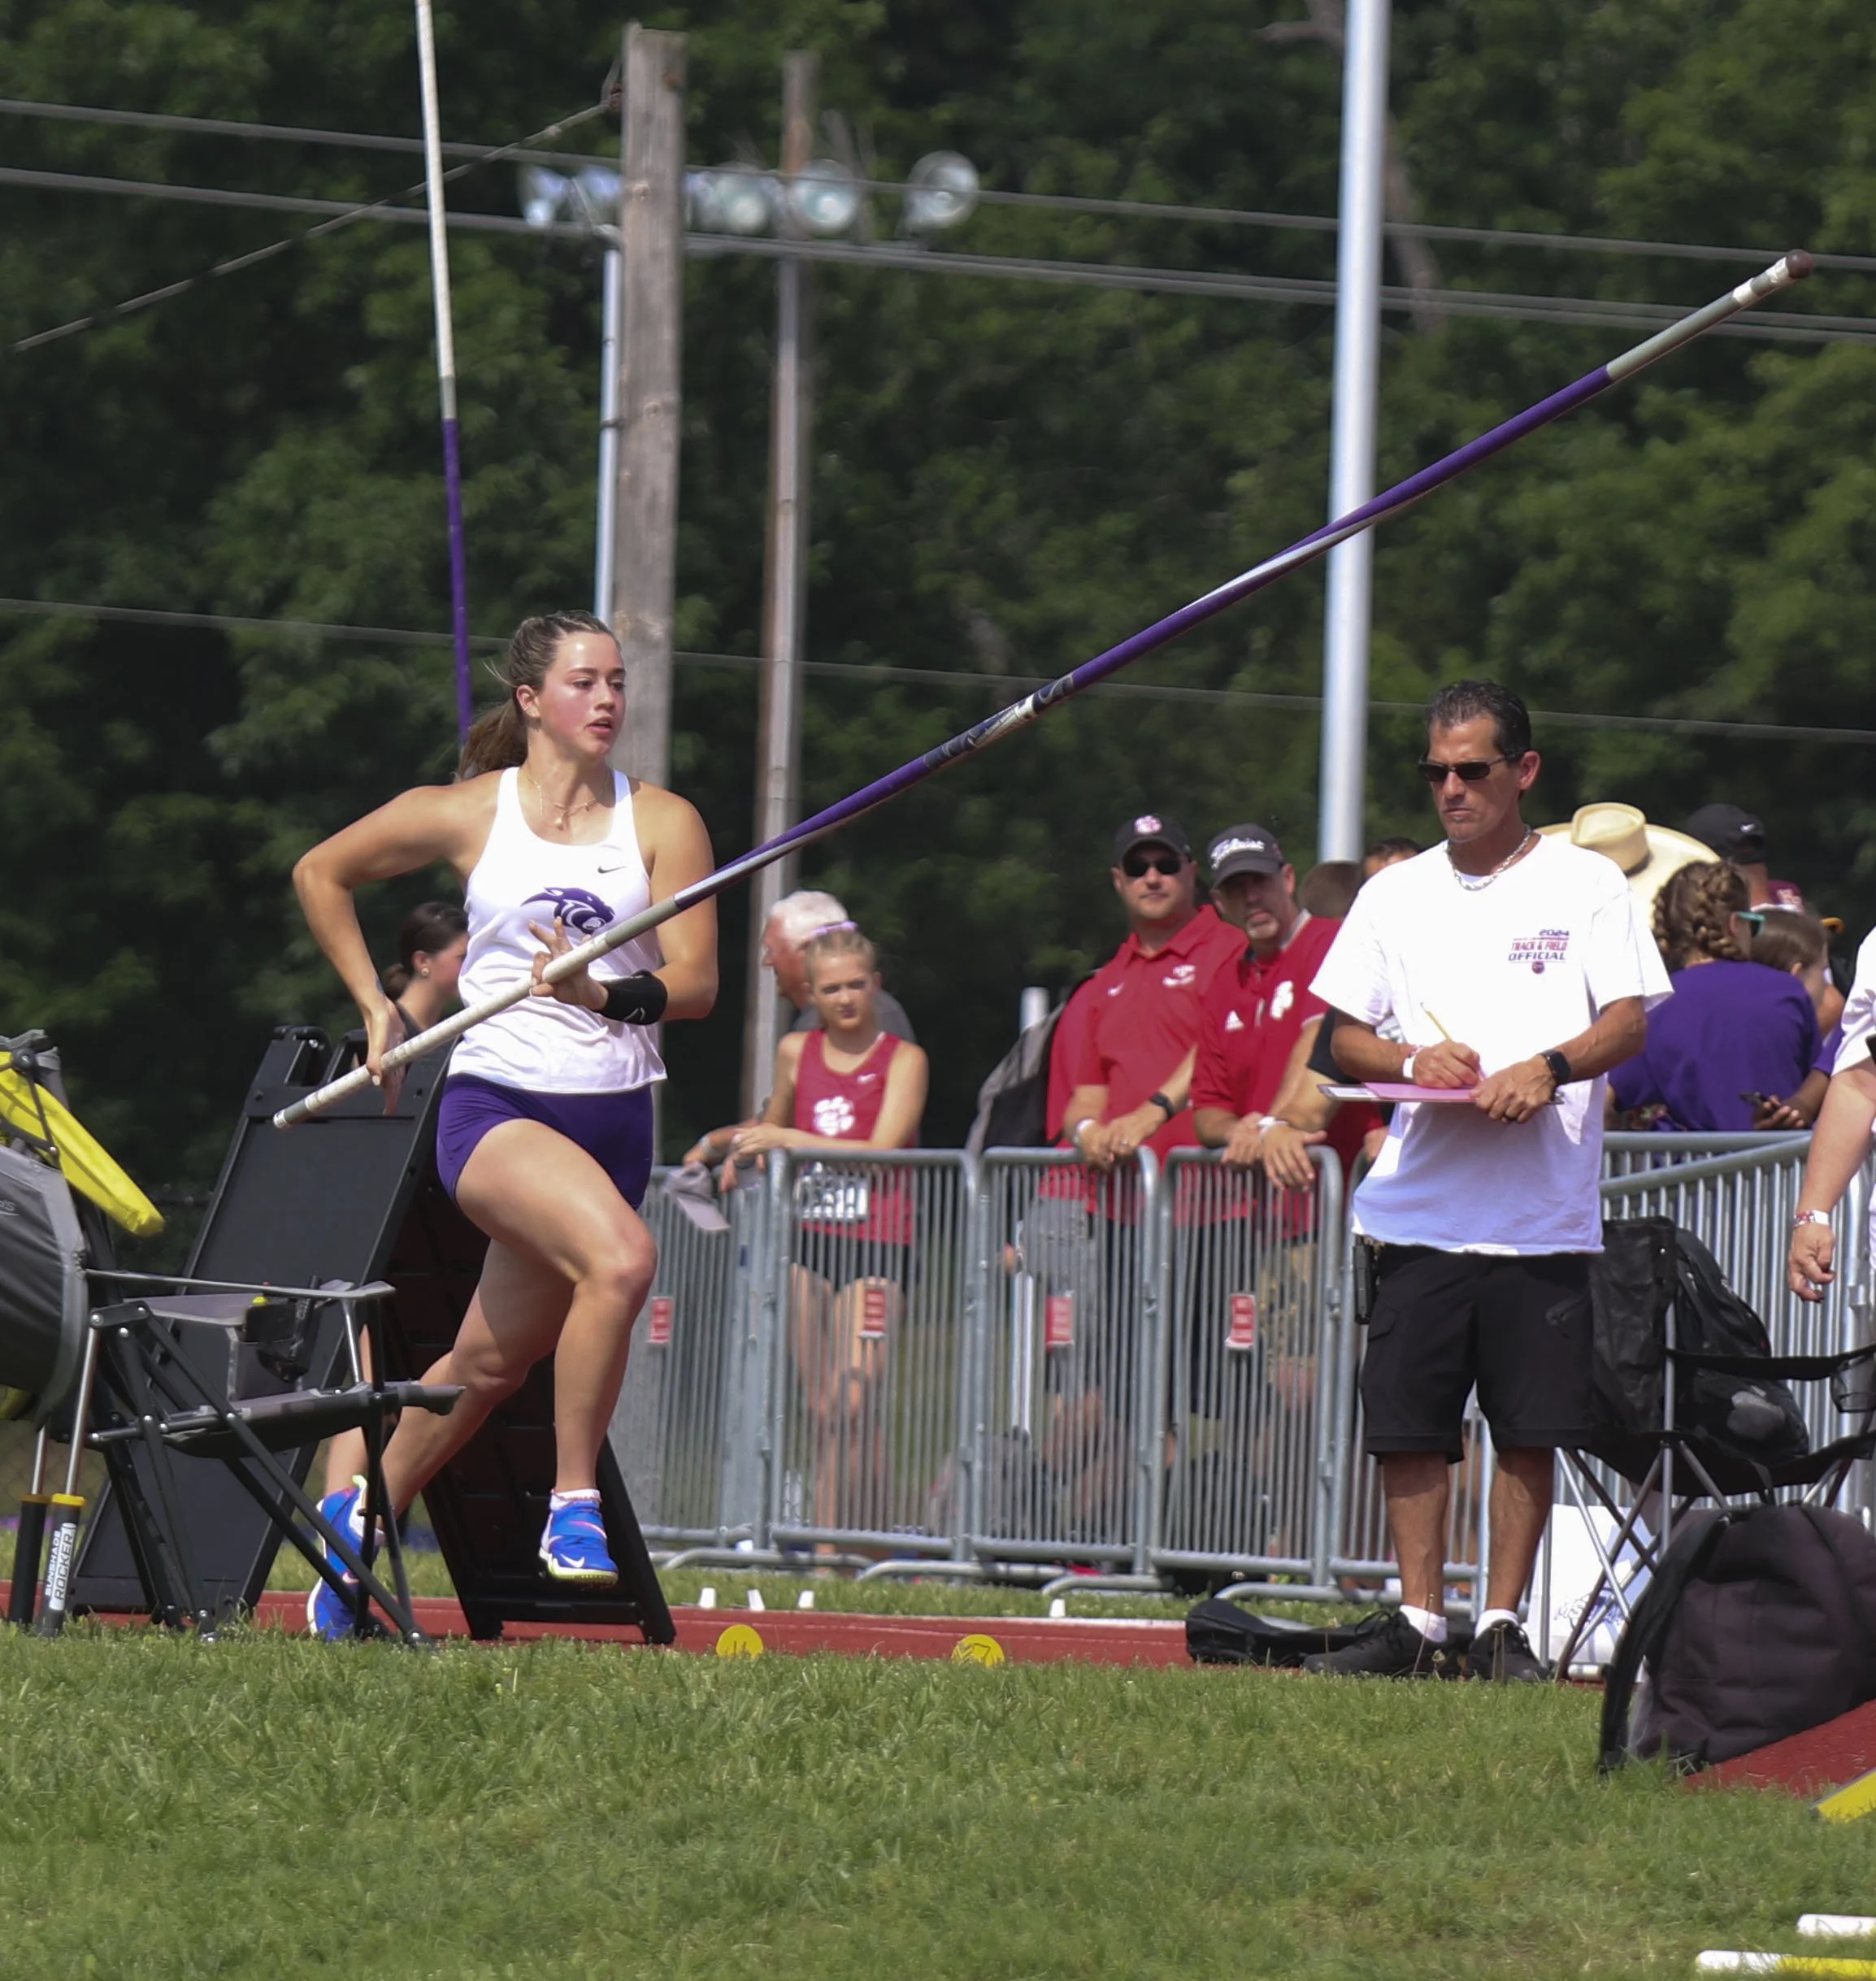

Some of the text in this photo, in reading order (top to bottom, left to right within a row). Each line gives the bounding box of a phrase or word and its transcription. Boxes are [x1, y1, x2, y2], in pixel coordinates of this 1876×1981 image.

[1539, 929, 1570, 937] 2024
[1509, 951, 1566, 961] OFFICIAL
[46, 1530, 61, 1596] SUNSHADE
[54, 1533, 73, 1601] ROCKER
